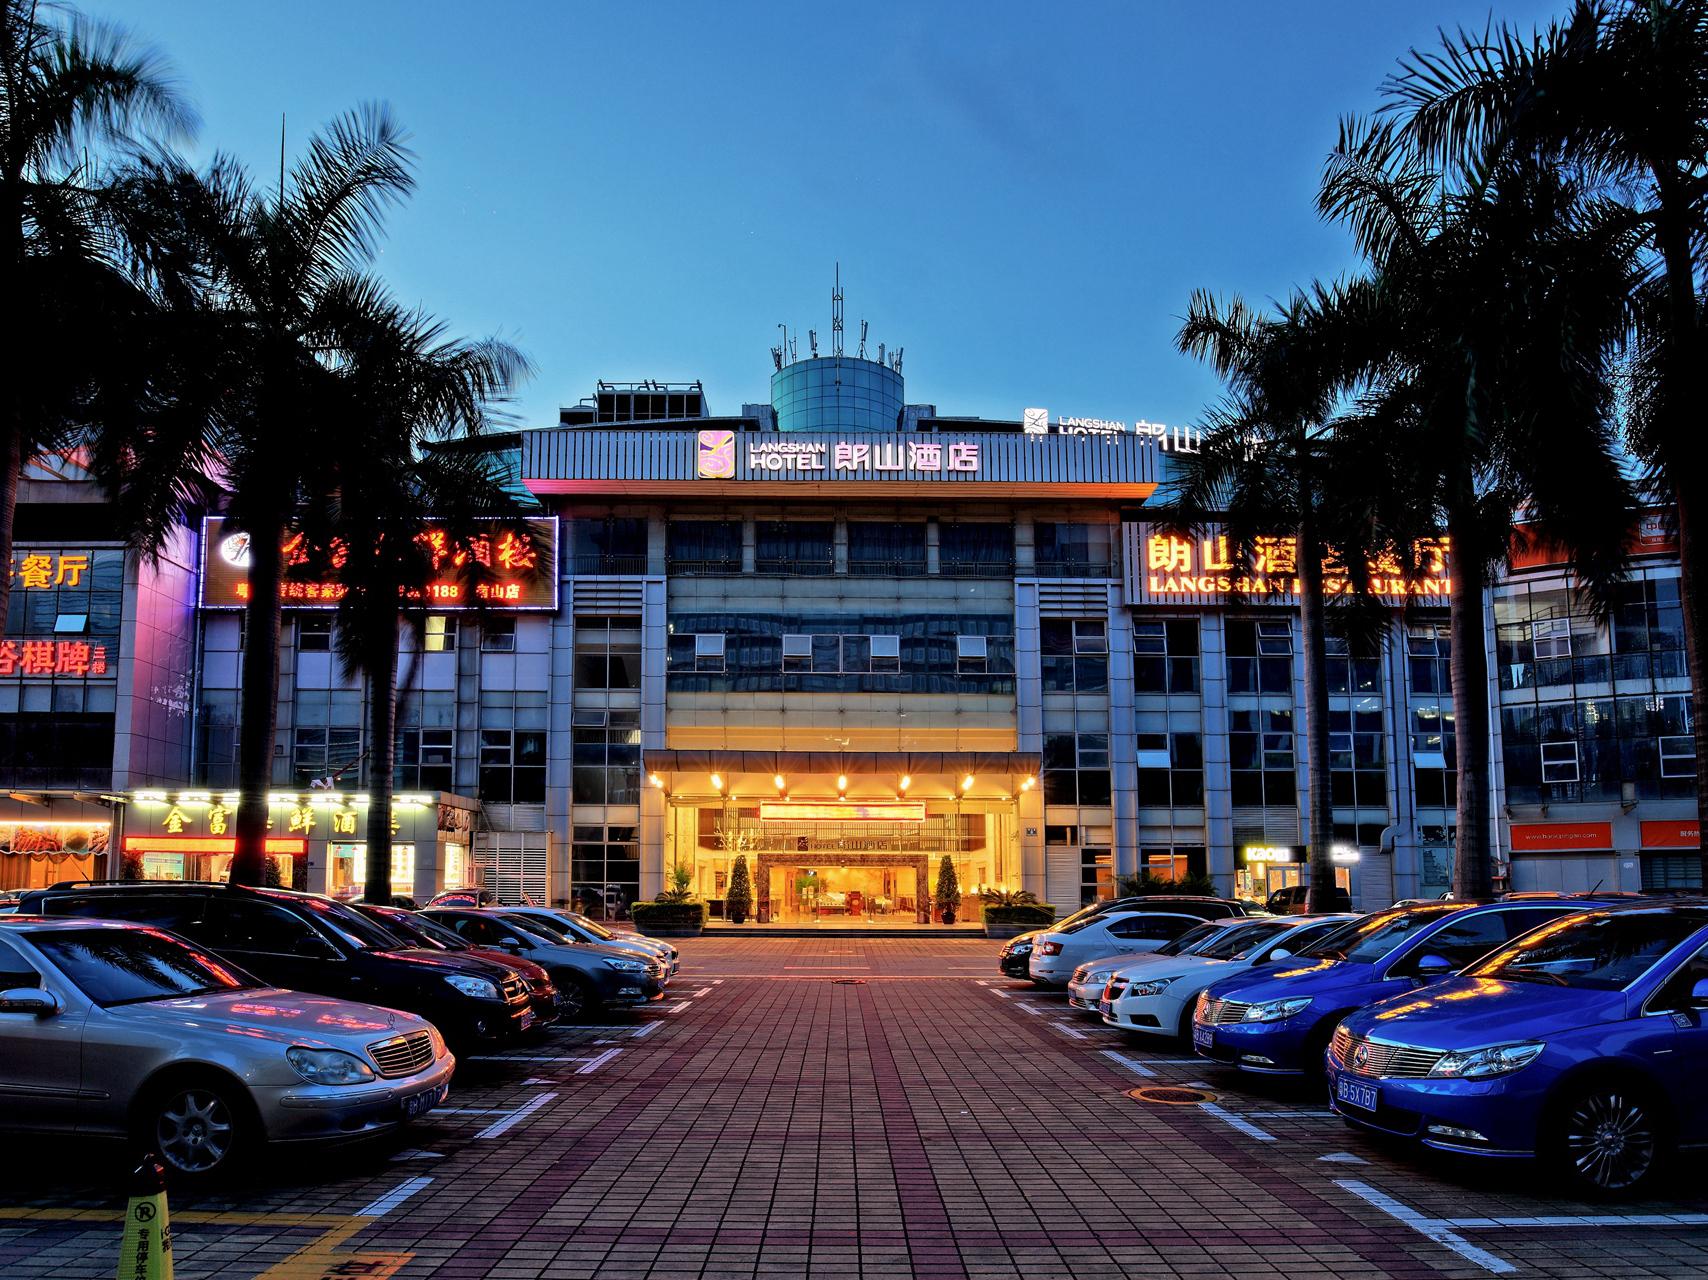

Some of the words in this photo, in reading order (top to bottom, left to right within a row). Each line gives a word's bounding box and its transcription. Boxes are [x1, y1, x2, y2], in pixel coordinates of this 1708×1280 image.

[1058, 416, 1126, 431] LANGSHAN
[750, 442, 826, 453] LANGSHAN
[834, 441, 979, 472] 朗山酒店
[750, 453, 826, 471] HOTEL
[9, 553, 88, 590] 餐厅
[161, 805, 401, 836] 金富鲜酒
